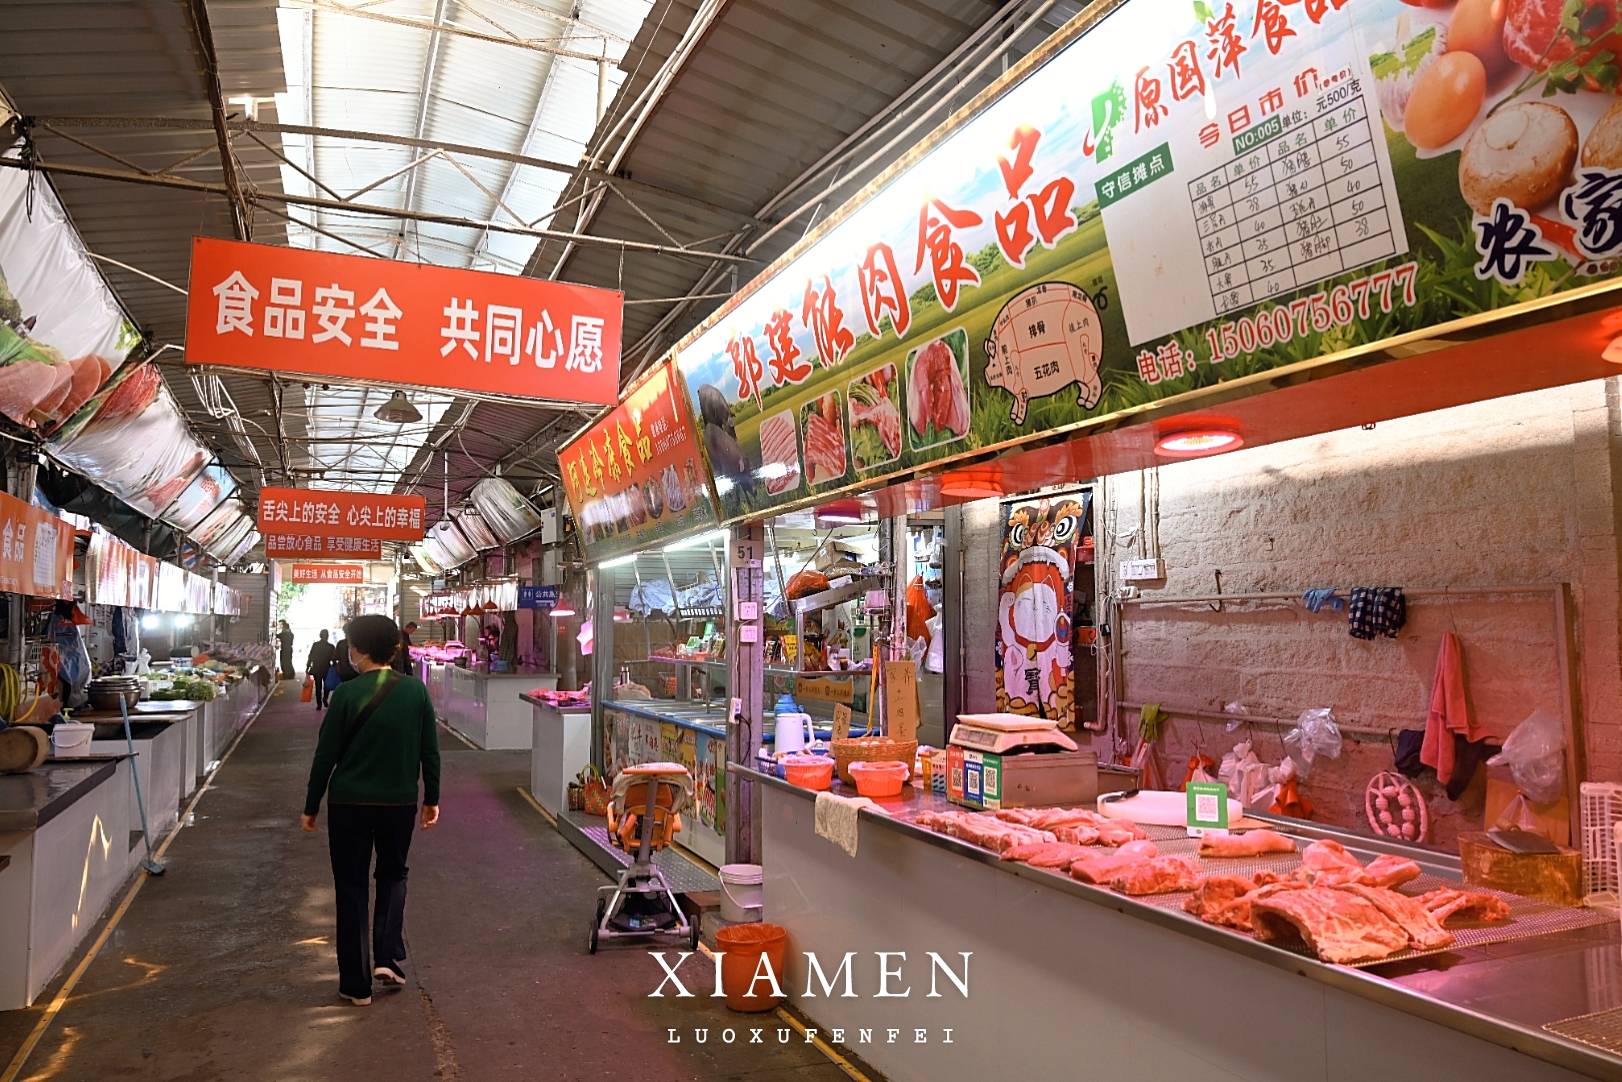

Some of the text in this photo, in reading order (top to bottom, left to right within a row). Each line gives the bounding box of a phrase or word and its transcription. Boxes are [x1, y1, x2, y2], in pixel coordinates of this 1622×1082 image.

[1198, 67, 1319, 149] 今日市价
[1234, 119, 1280, 151] NO:005
[1335, 134, 1350, 151] 55
[1196, 107, 1357, 195] 品名 单价 品名 单价
[1101, 154, 1166, 199] 守信摊点
[1340, 157, 1353, 173] 50
[1254, 221, 1266, 233] 40
[1347, 180, 1361, 194] 40
[1351, 200, 1365, 215] 50
[1355, 217, 1370, 236] 38
[1267, 281, 1280, 294] 40
[212, 270, 605, 374] 食品安全 共同心愿
[1205, 262, 1418, 363] 15060756777
[1028, 320, 1046, 339] 排骨
[1033, 360, 1060, 380] 五花肉
[263, 500, 421, 529] 舌尖上的安全 心尖上的幸福
[2, 518, 26, 563] 食品
[268, 535, 379, 552] 品尝放心食品 享受健康生活
[737, 546, 753, 559] 51
